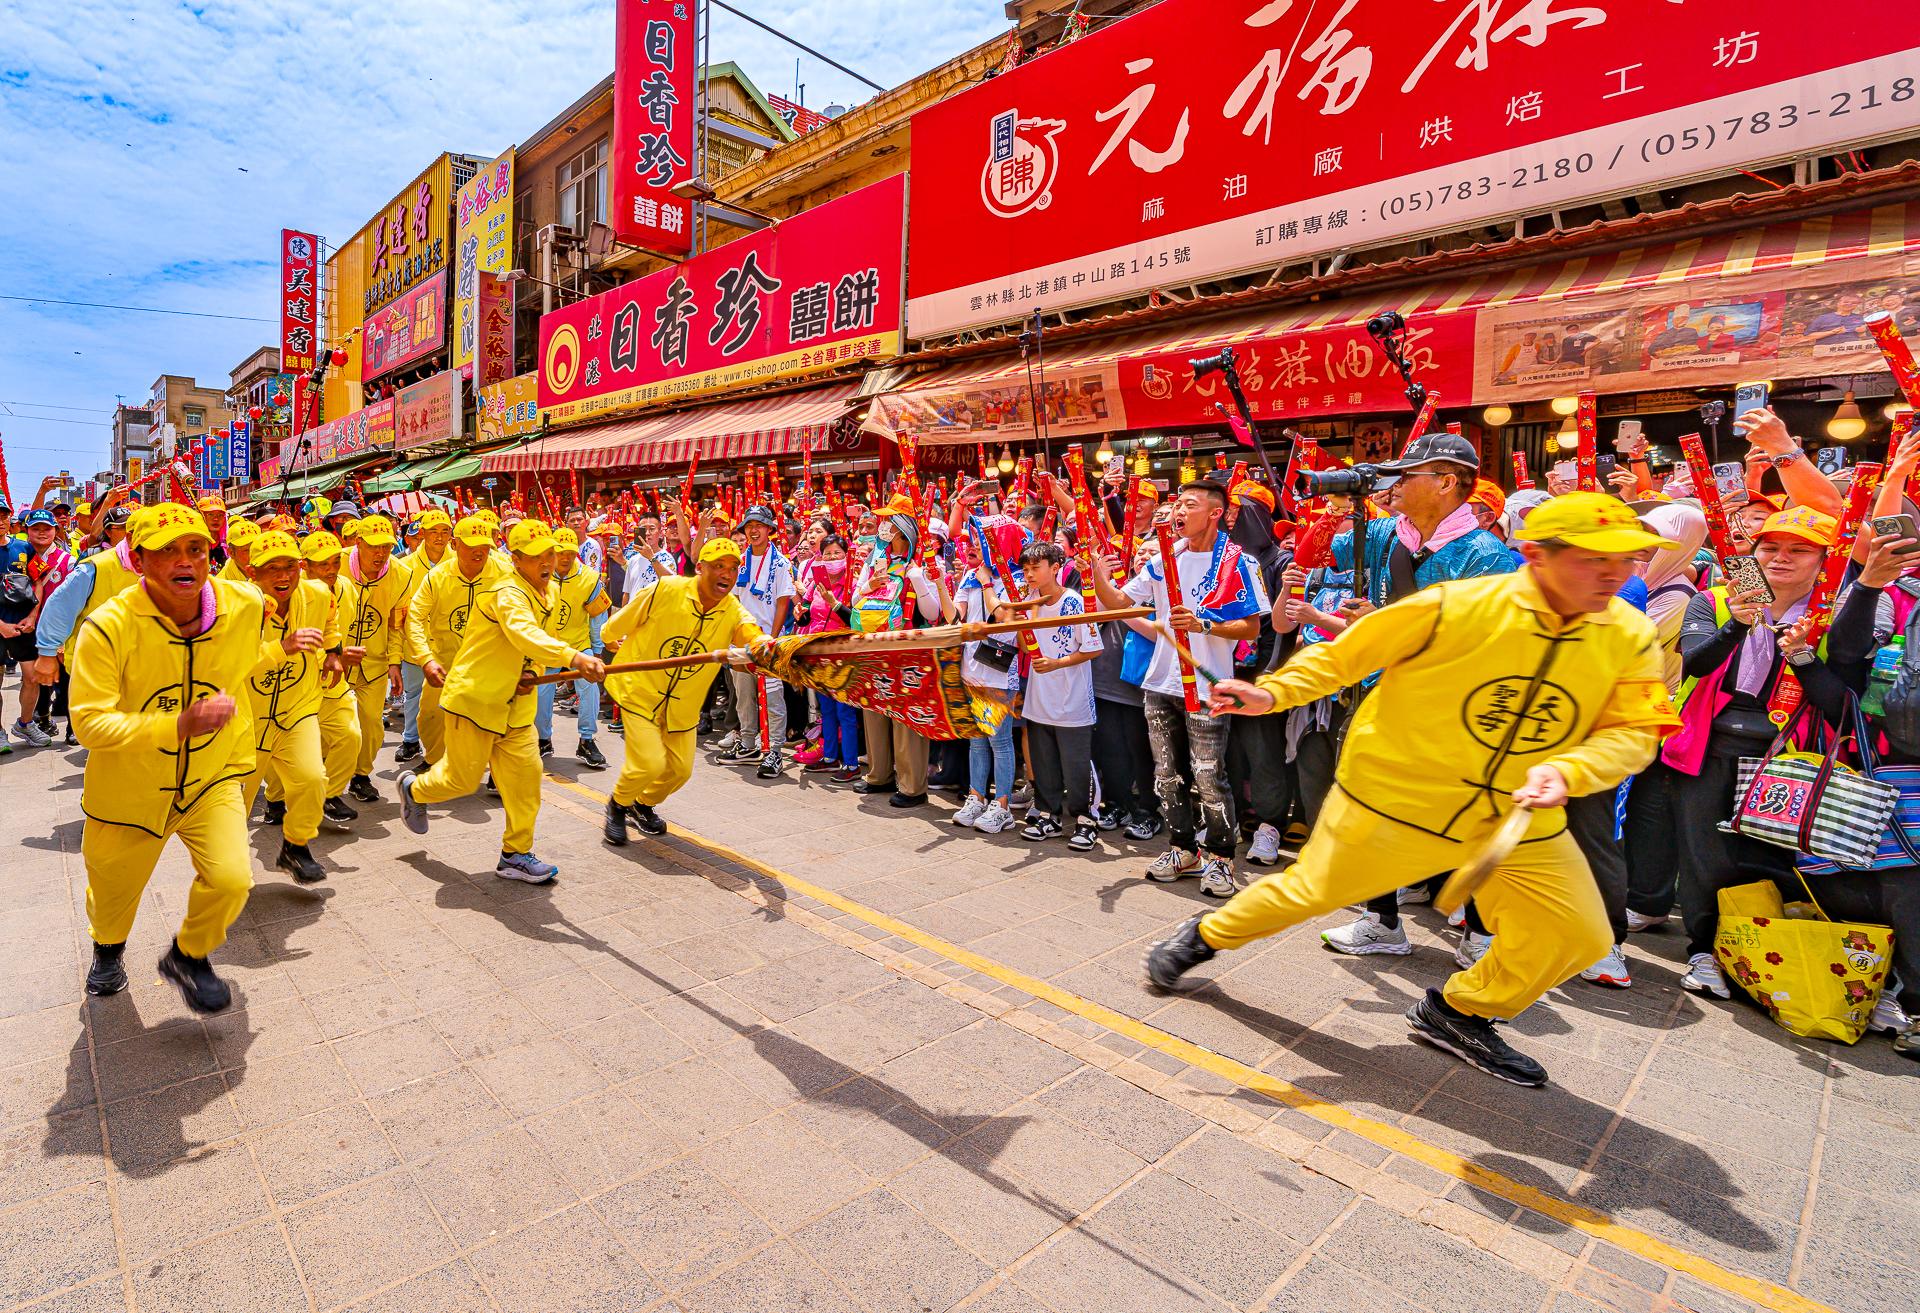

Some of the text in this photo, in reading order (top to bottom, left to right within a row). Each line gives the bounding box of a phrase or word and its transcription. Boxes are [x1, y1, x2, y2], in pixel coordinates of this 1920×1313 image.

[635, 20, 687, 188] 日香珍
[1419, 30, 1760, 149] 烘焙工坊
[633, 196, 684, 235] 囍餅
[1142, 146, 1343, 223] 麻油廠
[1380, 153, 1594, 222] (05)783-2180
[286, 267, 313, 355] 美達香
[610, 250, 782, 374] 日香珍
[789, 268, 879, 344] 囍餅
[970, 246, 1192, 311] 雲林縣北港鎮中山路145號
[585, 313, 602, 387] 北港
[800, 339, 882, 368] 全省專車送達
[233, 426, 247, 476] 元內科醫院
[1520, 695, 1563, 743] 天上
[1757, 782, 1790, 816] 勇
